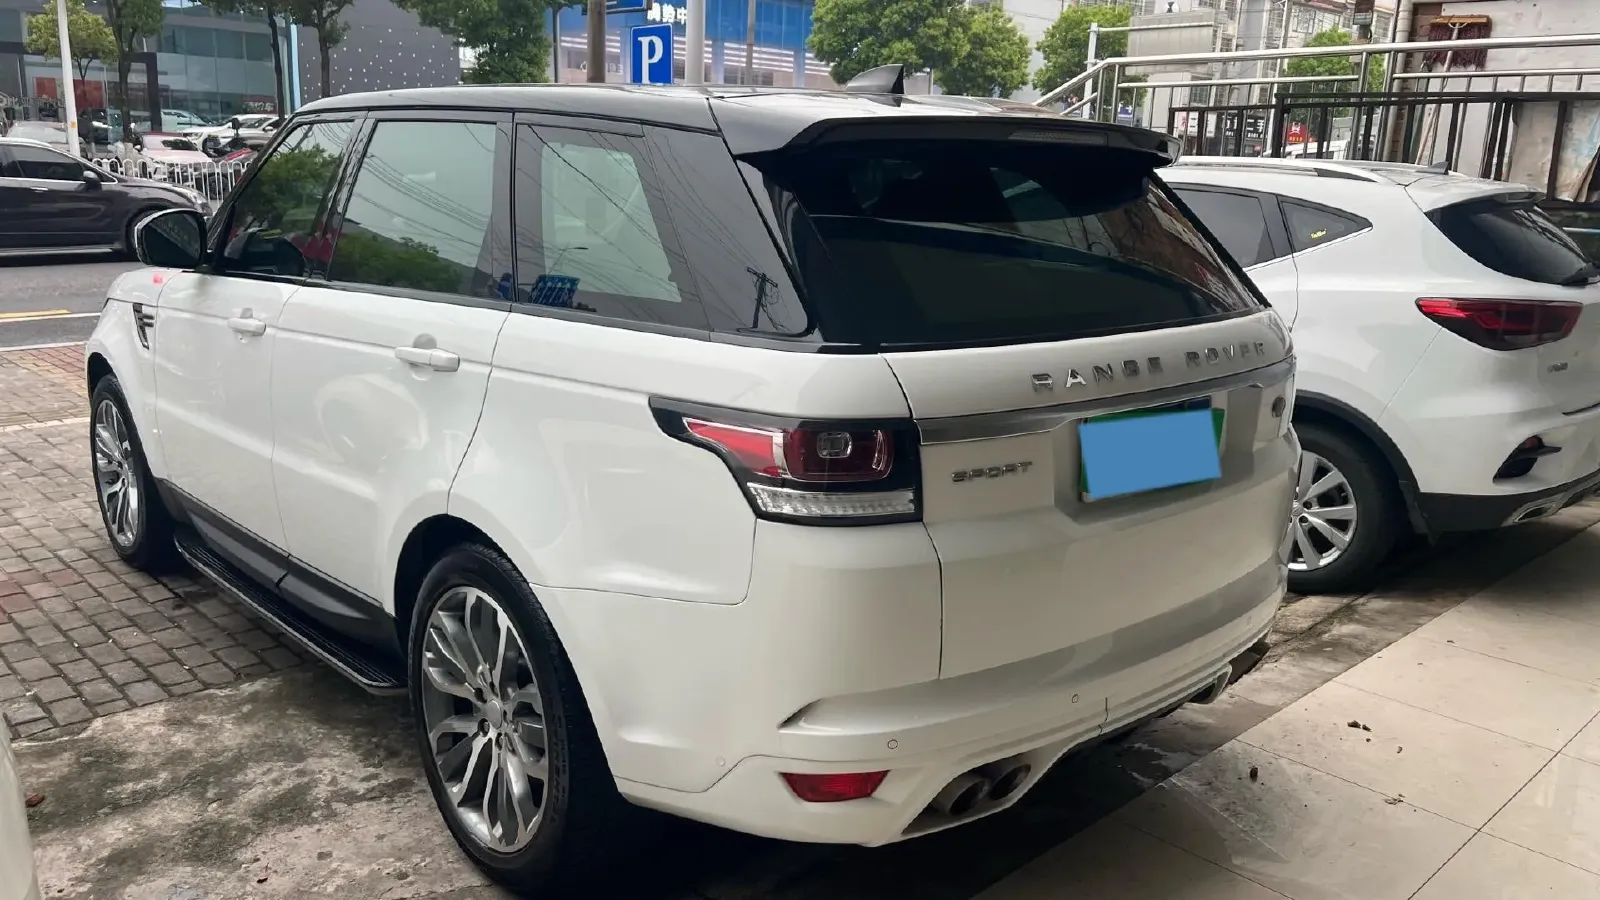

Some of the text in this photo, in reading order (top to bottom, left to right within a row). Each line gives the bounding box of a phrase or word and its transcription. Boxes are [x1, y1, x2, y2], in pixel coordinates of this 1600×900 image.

[638, 35, 663, 84] P
[1030, 356, 1164, 392] RANGE
[951, 460, 1033, 482] SPORT
